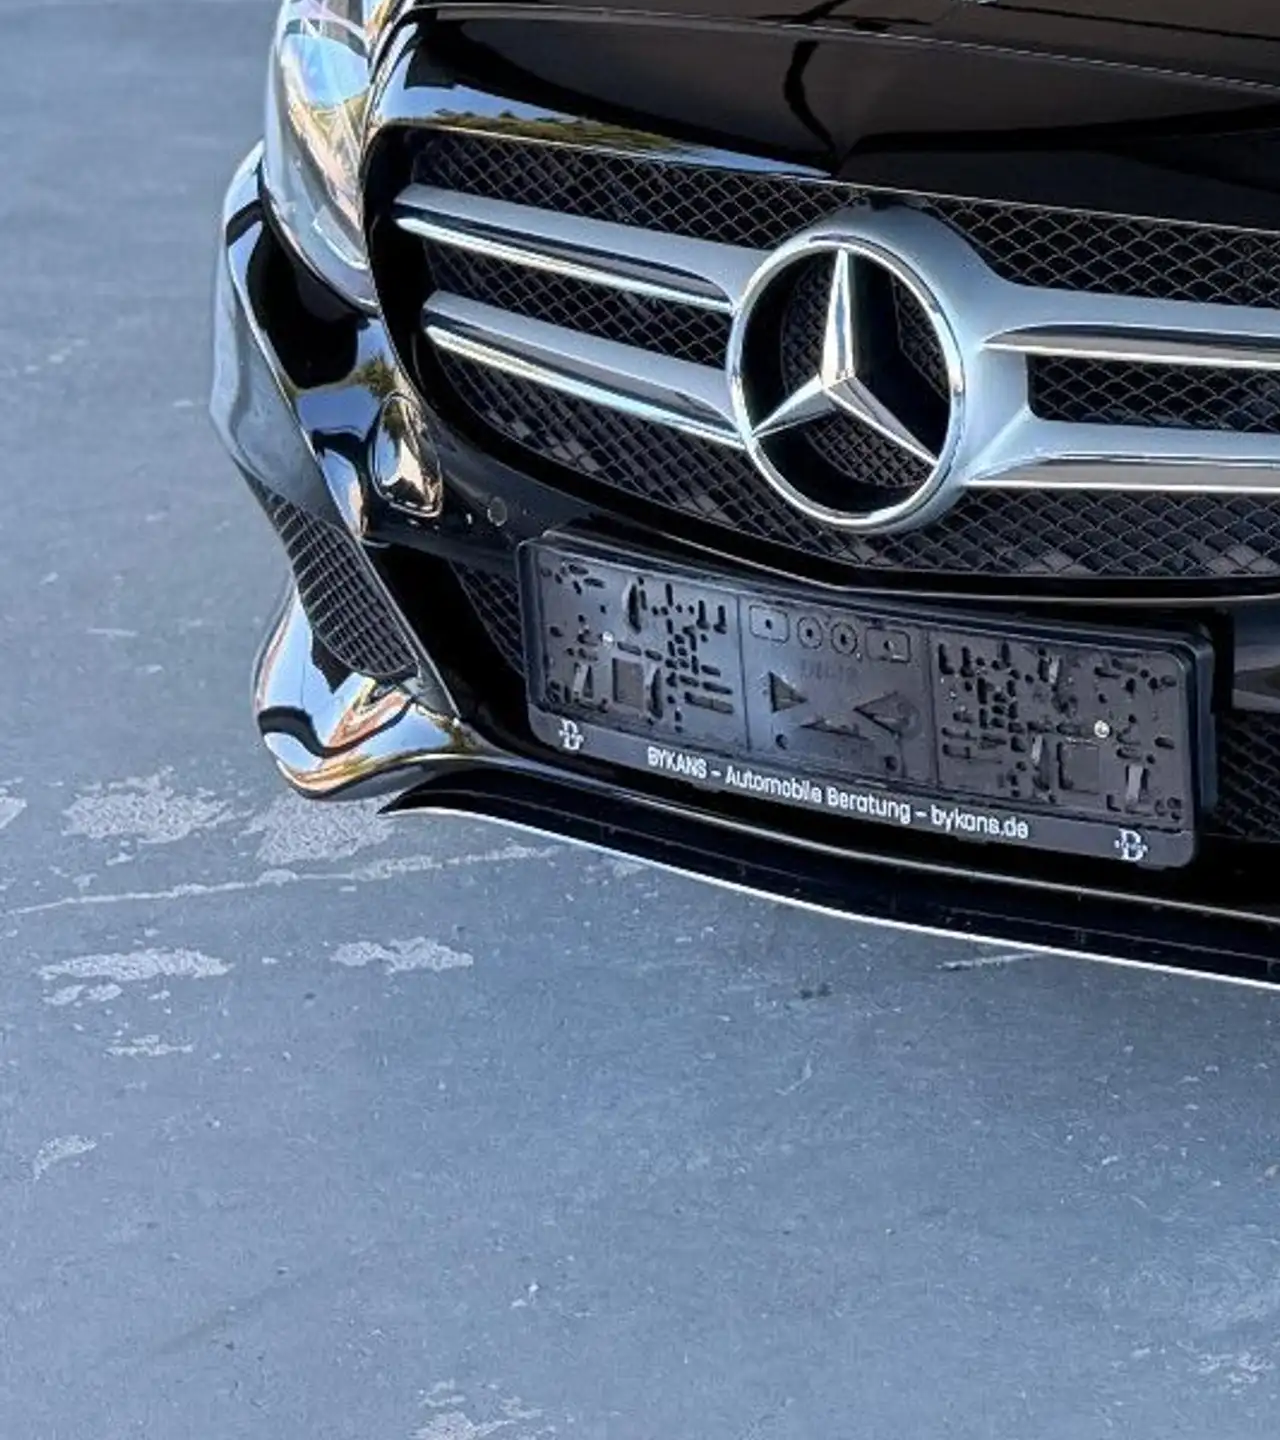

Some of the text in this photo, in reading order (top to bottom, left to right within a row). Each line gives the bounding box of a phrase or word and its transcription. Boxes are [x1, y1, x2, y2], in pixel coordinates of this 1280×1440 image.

[647, 745, 708, 780] BYKANS
[725, 765, 822, 804] Automobile
[826, 786, 912, 825] Beratung
[930, 804, 1029, 840] bykans.de
